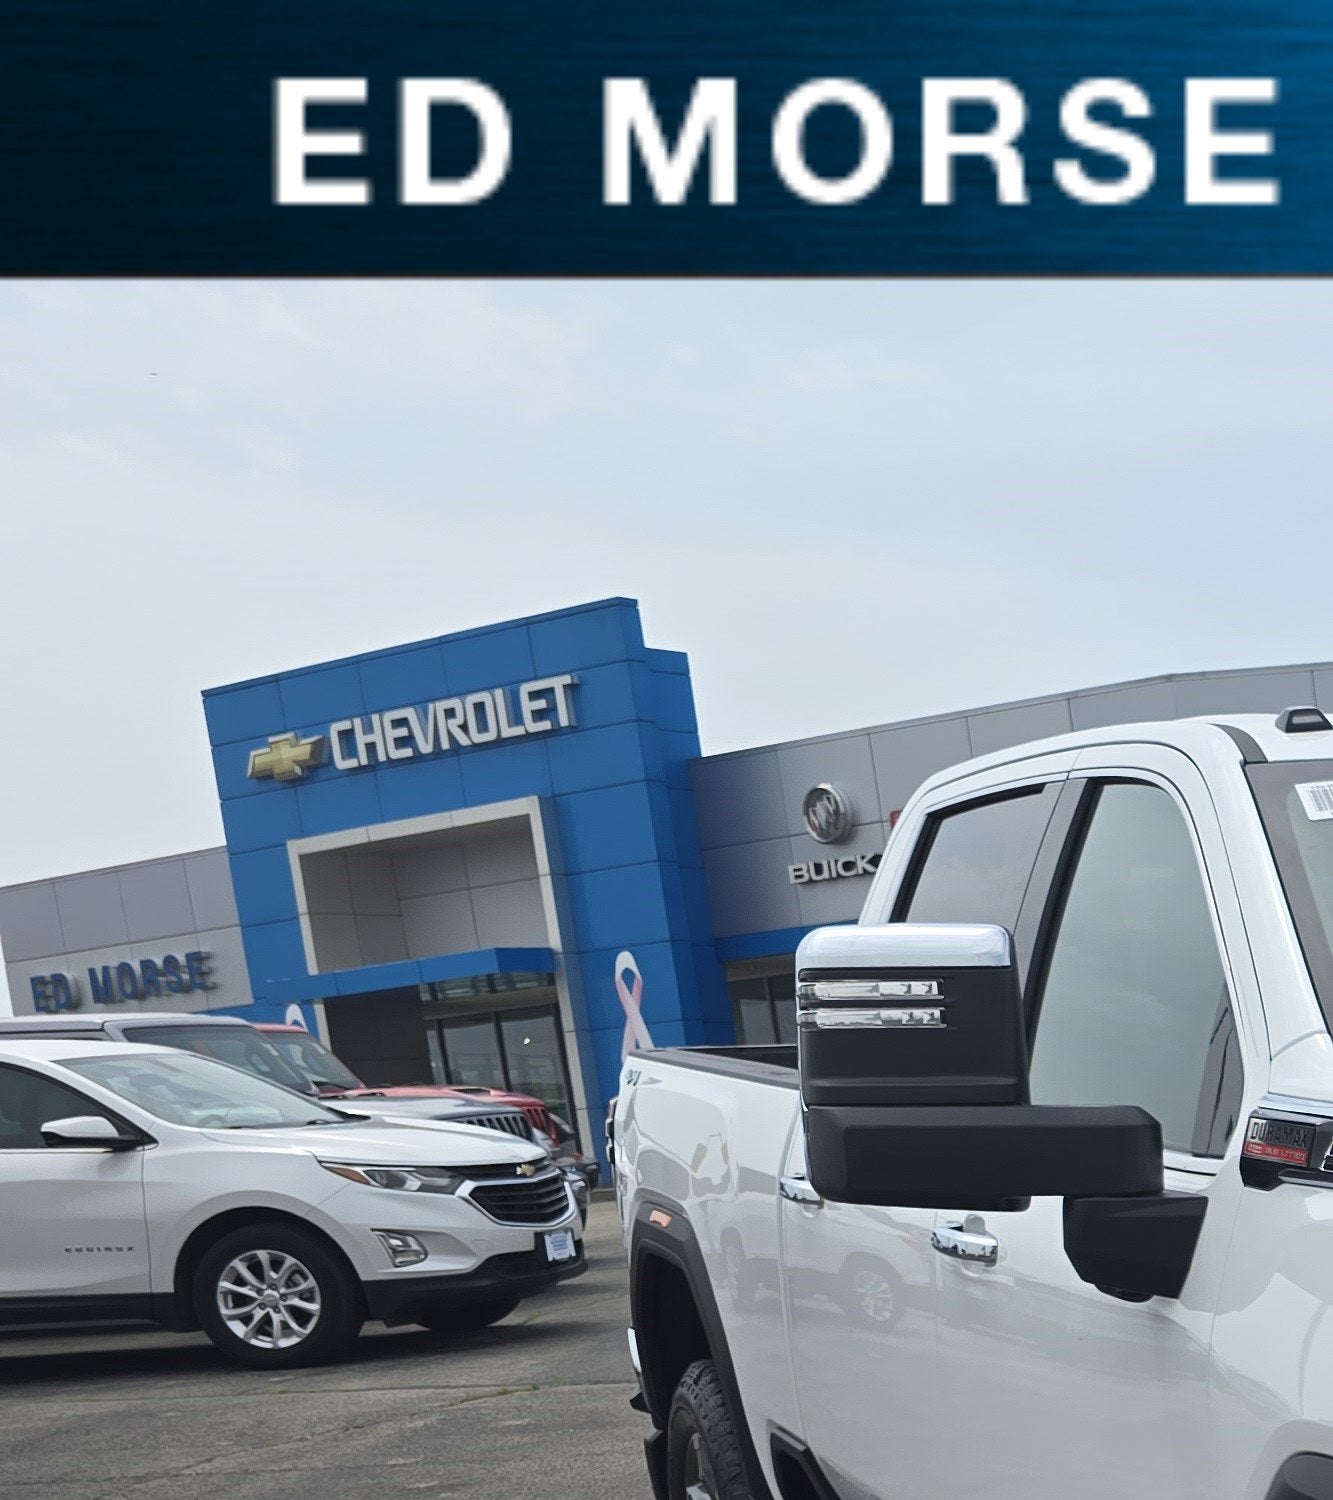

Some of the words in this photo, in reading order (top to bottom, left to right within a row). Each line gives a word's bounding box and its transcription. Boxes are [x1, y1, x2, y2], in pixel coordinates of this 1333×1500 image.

[329, 674, 577, 771] CHEVROLET
[788, 853, 880, 885] BUICK
[30, 973, 76, 1013] ED
[88, 951, 213, 1004] MORSE
[1250, 1121, 1312, 1147] DURAMAX
